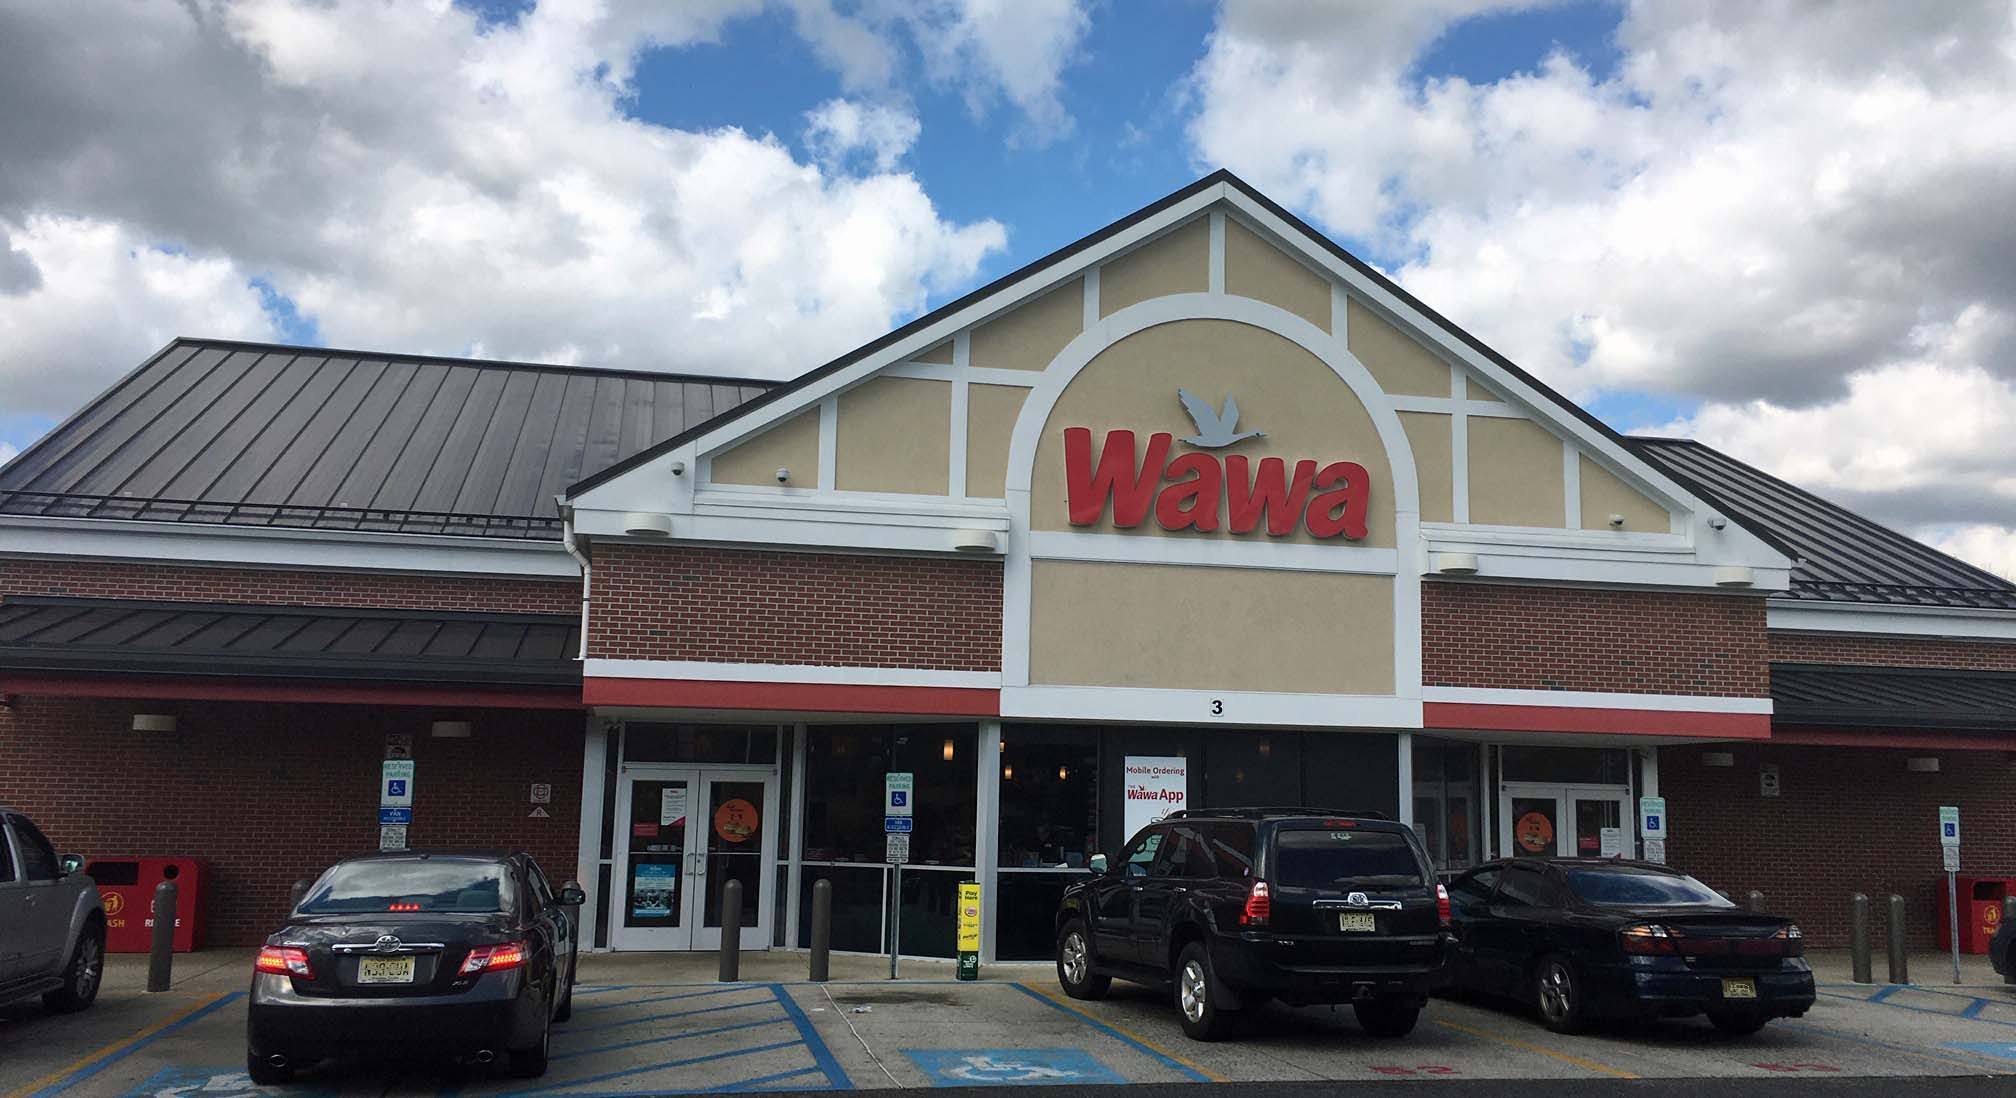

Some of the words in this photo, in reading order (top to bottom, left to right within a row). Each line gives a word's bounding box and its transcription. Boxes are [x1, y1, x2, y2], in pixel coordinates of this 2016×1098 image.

[1064, 427, 1370, 540] Wawa
[1212, 700, 1223, 714] 3
[1126, 766, 1151, 774] Mobile
[1153, 767, 1185, 776] Ordering
[1127, 789, 1158, 800] Wawa
[1159, 788, 1184, 804] App
[106, 919, 125, 928] ASH
